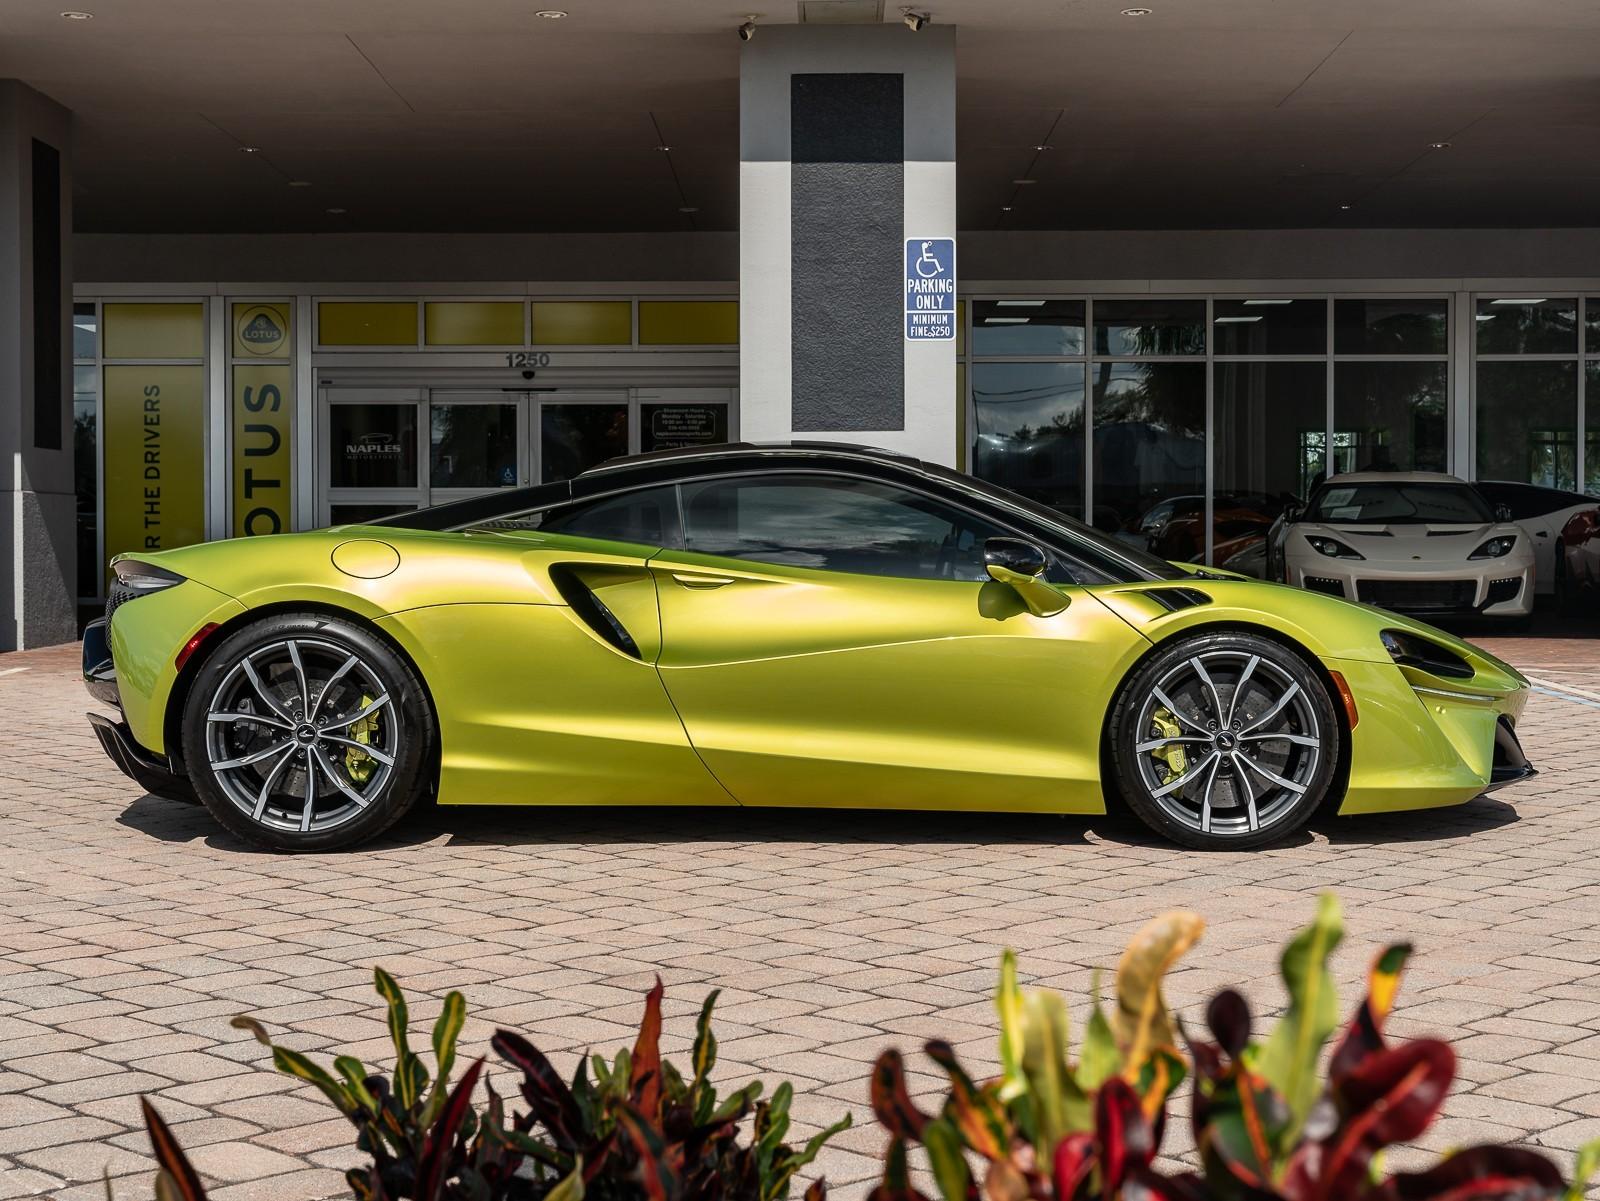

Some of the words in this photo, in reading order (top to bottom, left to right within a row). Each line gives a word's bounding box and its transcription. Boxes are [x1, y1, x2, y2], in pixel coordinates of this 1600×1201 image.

[907, 278, 953, 293] PARKING
[916, 295, 944, 309] ONLY
[912, 314, 948, 325] MINIMUM
[245, 330, 279, 339] LOTUS
[910, 326, 928, 337] FINE
[930, 326, 950, 337] $250
[505, 352, 550, 368] 1250
[143, 385, 161, 480] DRIVERS
[346, 444, 401, 453] NAPLES
[243, 384, 282, 537] OTUS
[144, 486, 161, 530] THE
